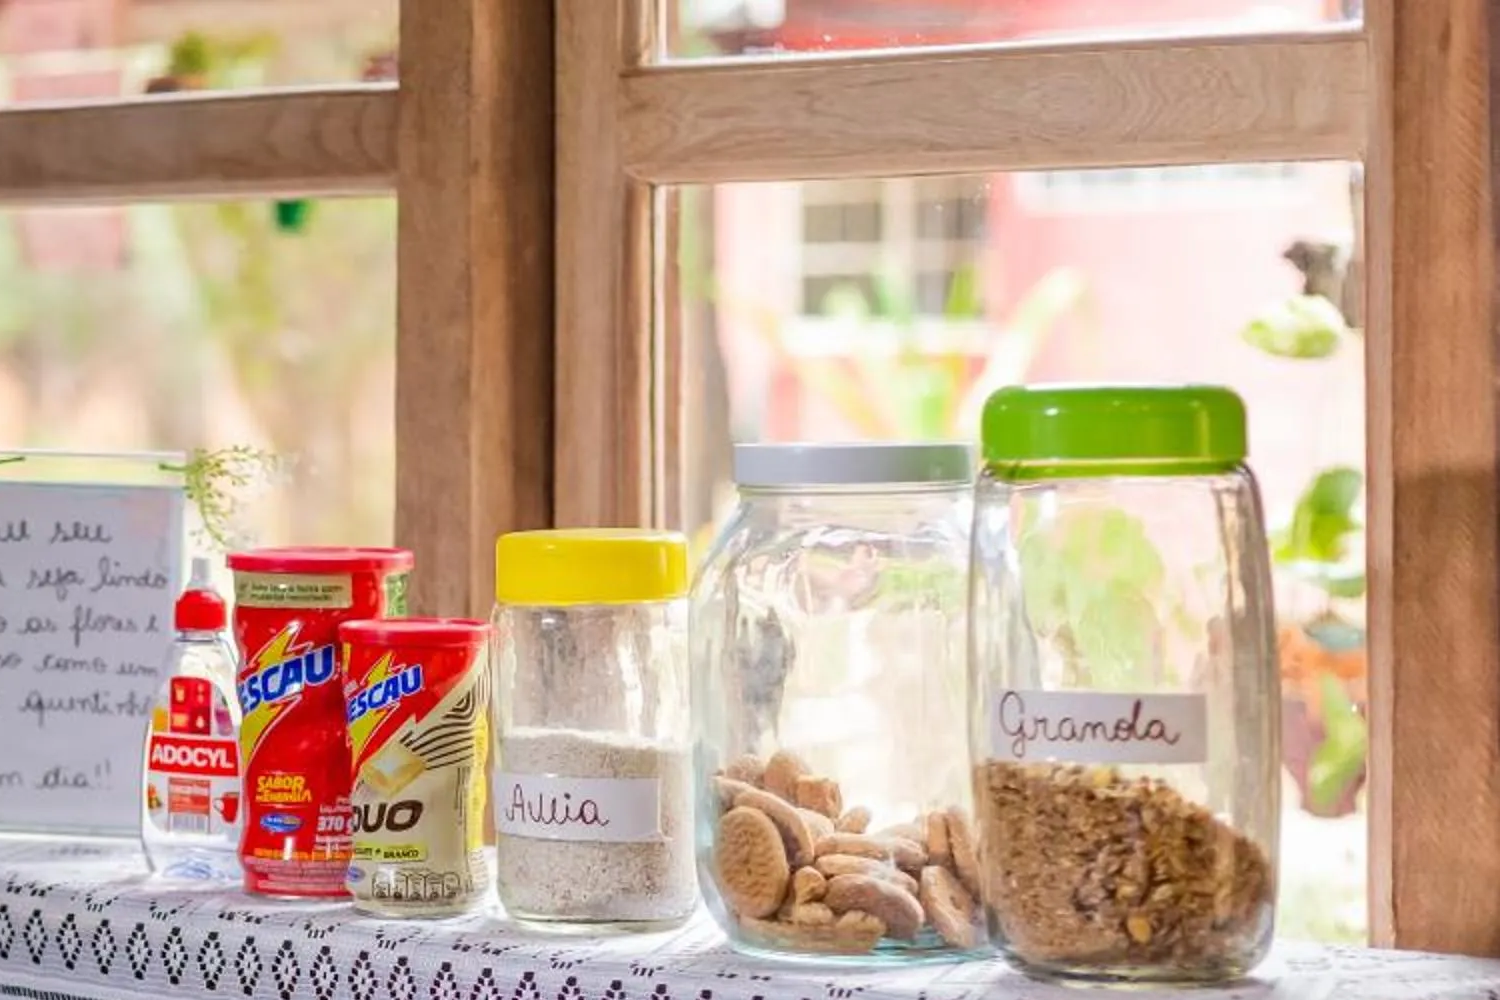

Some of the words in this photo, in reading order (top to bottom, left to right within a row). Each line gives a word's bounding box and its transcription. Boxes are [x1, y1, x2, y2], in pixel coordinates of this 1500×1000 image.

[49, 520, 113, 544] seu
[26, 566, 86, 602] seja
[90, 556, 169, 592] lindo
[16, 616, 59, 635] as
[69, 604, 139, 648] flores
[33, 653, 108, 675] como
[116, 661, 159, 677] um
[999, 690, 1183, 758] Granola
[151, 742, 235, 771] ADOCYL
[505, 783, 611, 827] Aveia
[316, 815, 345, 832] 370
